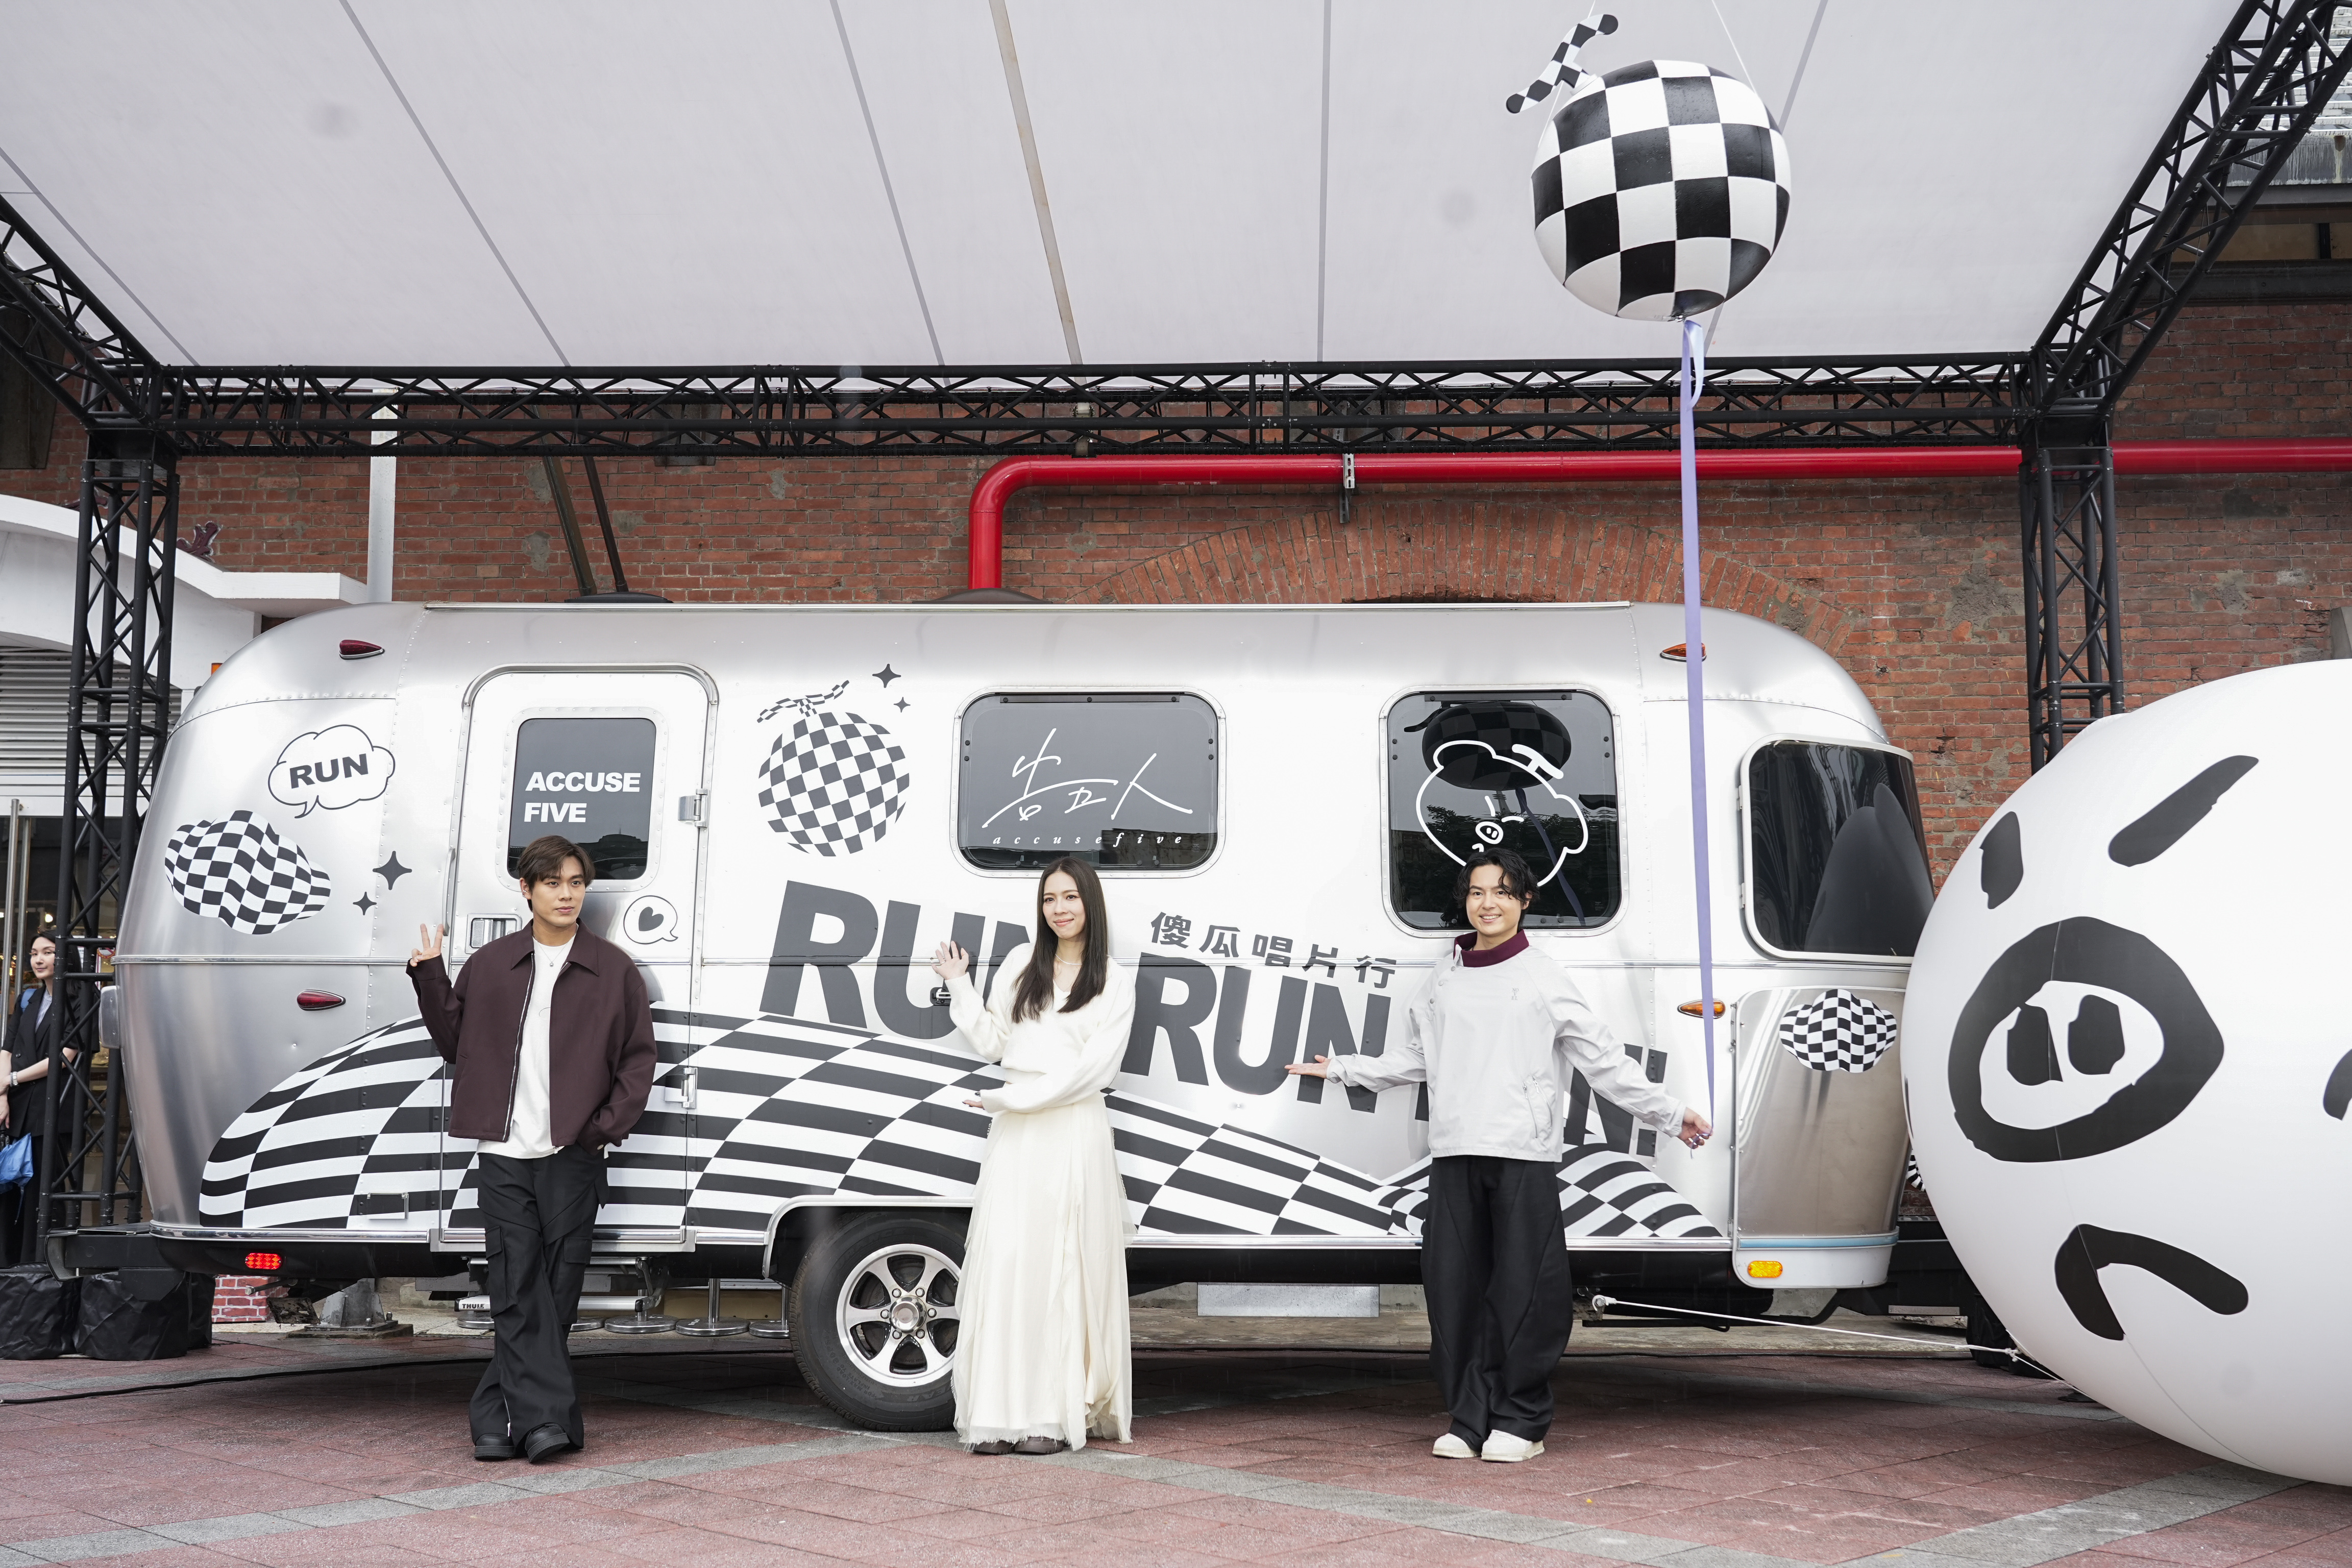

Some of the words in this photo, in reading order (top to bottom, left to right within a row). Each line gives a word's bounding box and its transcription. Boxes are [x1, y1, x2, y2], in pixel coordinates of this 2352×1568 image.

[289, 753, 369, 789] RUN
[525, 771, 642, 792] ACCUSE
[524, 802, 587, 823] FIVE
[1150, 912, 1397, 989] 傻瓜唱片行
[1121, 952, 1391, 1114] RUN
